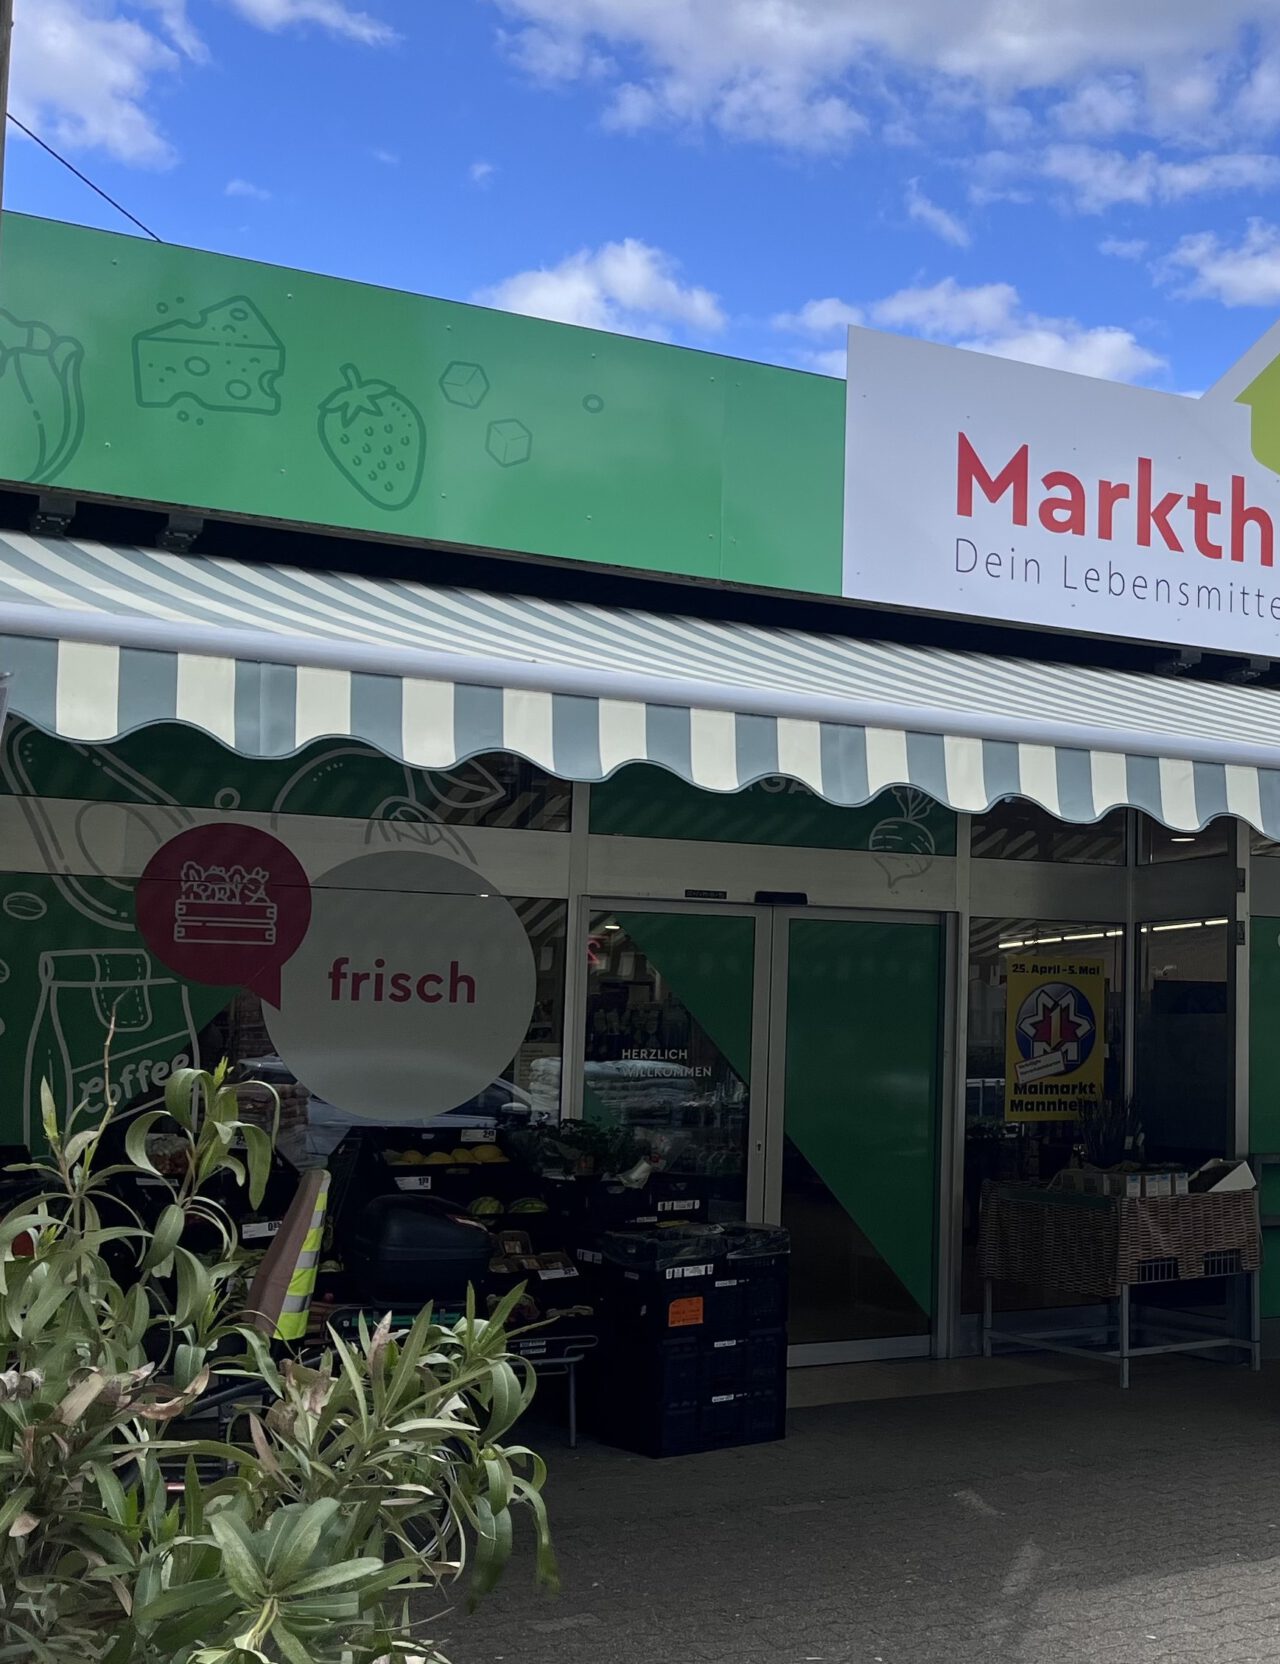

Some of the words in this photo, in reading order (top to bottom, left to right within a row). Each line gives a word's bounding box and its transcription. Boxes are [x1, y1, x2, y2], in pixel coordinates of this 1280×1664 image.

[955, 538, 1041, 584] Dein
[1012, 963, 1029, 974] 25.
[1031, 964, 1060, 976] April
[1079, 965, 1100, 976] Mai
[328, 957, 476, 1004] frisch
[621, 1048, 688, 1060] HERZLICH
[621, 1065, 712, 1078] WILLKOMMEN
[1013, 1081, 1096, 1096] Maimarkt
